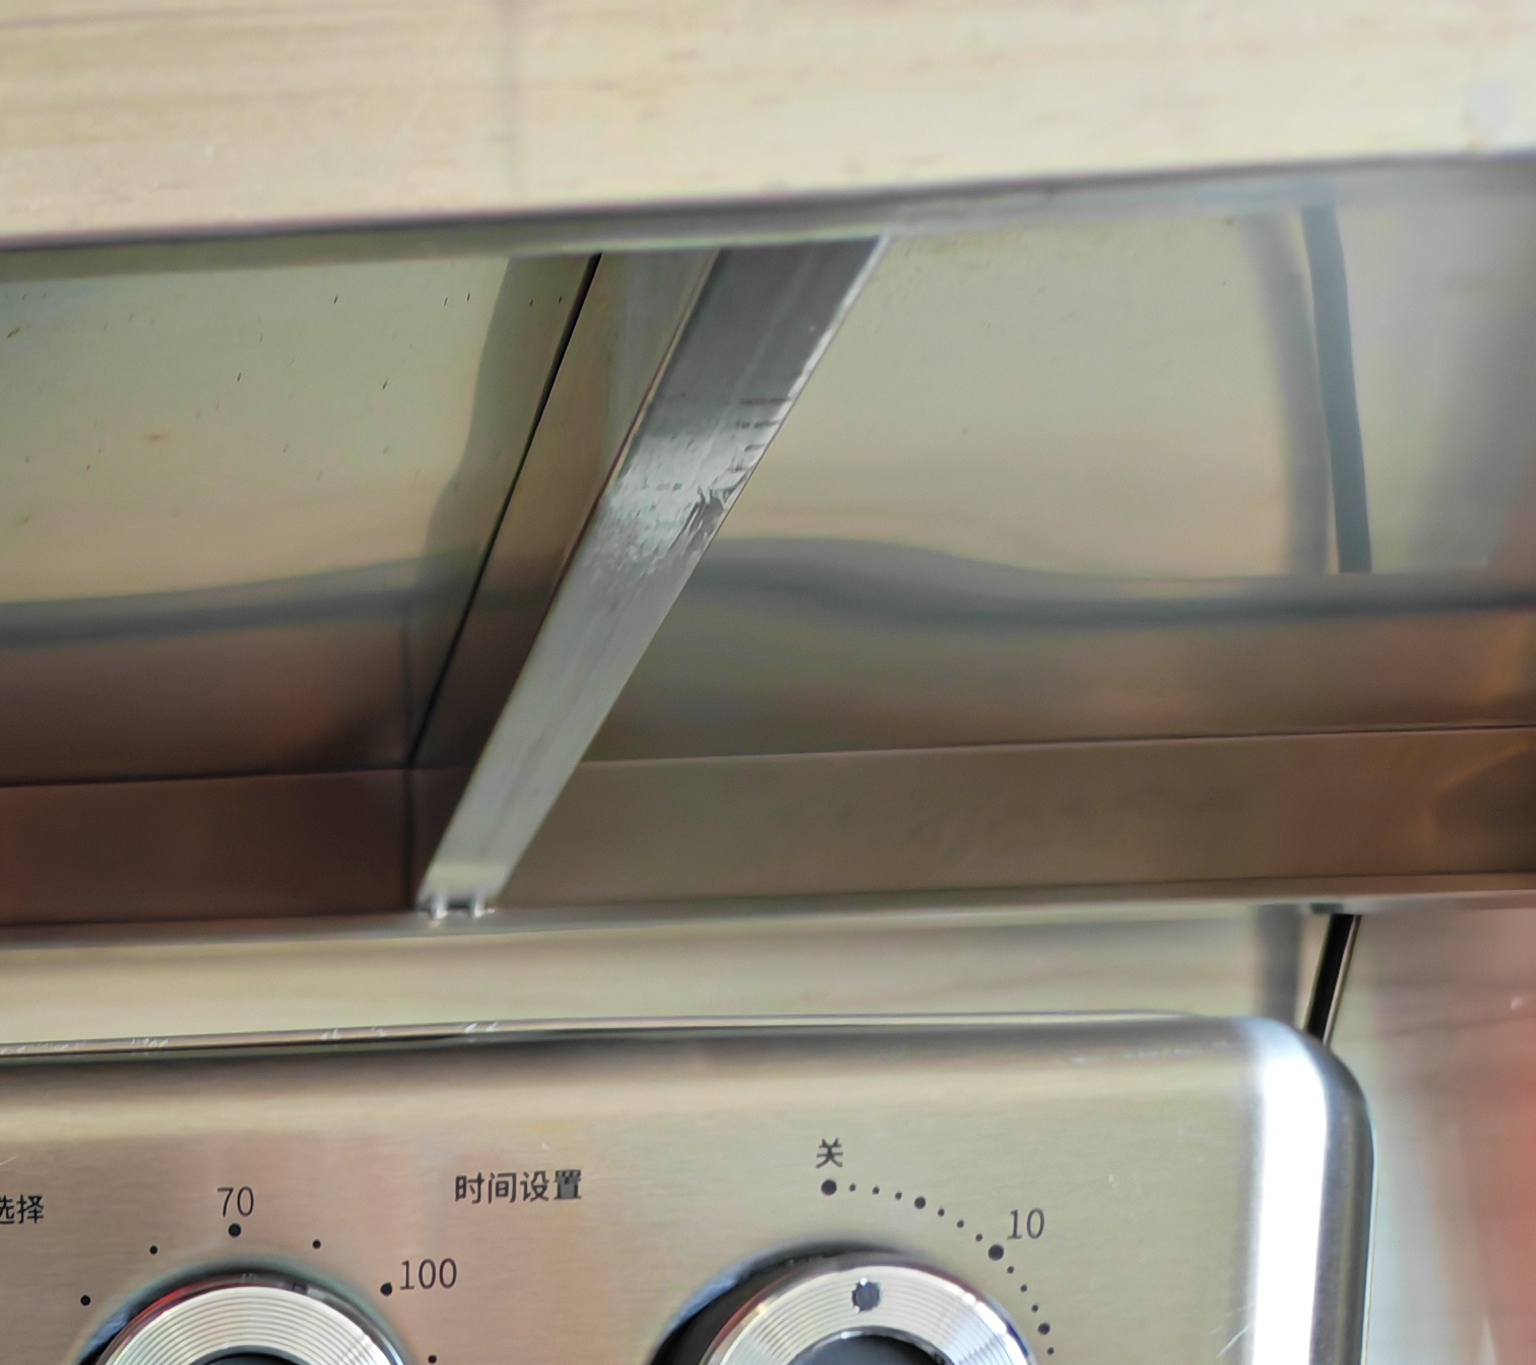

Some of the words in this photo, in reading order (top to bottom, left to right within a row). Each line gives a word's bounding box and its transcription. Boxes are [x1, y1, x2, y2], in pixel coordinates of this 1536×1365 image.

[814, 1137, 844, 1169] 关
[216, 1186, 256, 1218] 70
[454, 1169, 583, 1204] 时间设置
[1007, 1209, 1046, 1240] 10
[398, 1258, 458, 1291] 100
